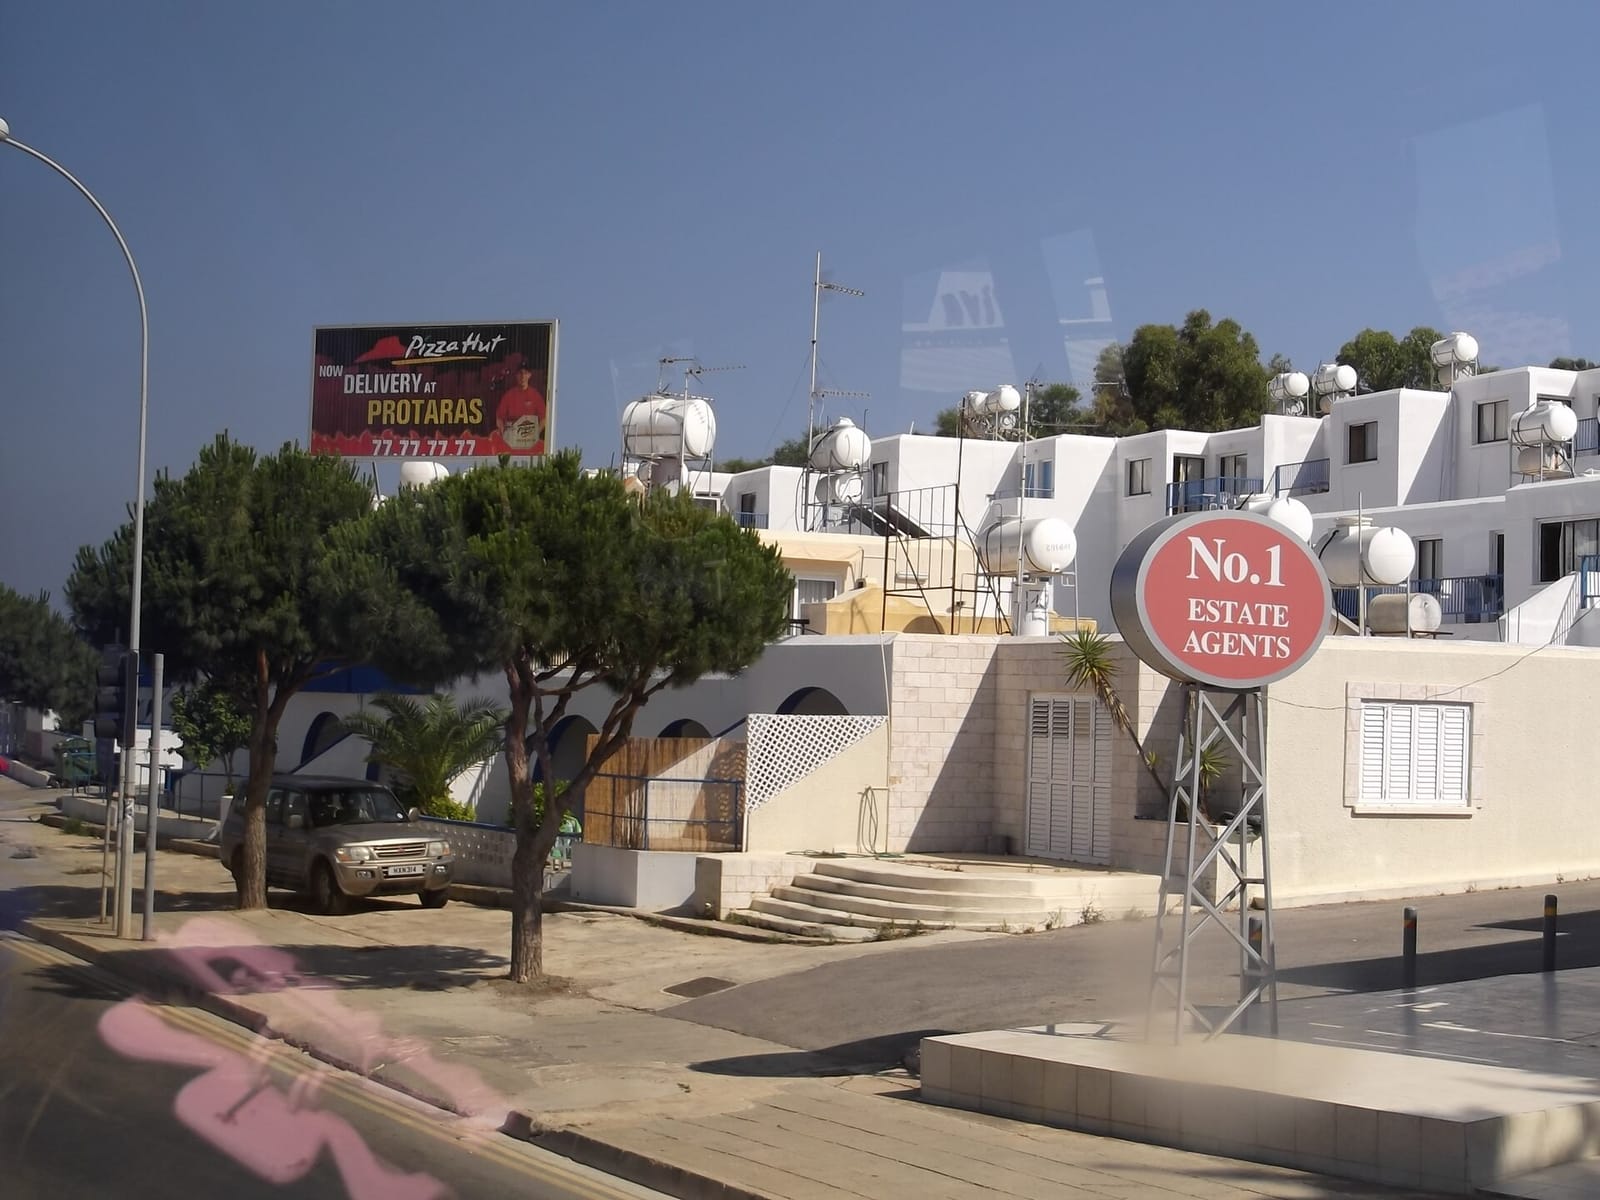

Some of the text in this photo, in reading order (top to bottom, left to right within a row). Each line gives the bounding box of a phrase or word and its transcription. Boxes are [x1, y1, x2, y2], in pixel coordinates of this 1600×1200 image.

[404, 331, 507, 358] Pizza Hut
[319, 365, 344, 378] NOW
[343, 373, 437, 394] DELIVERY AT
[367, 398, 484, 425] PROTARAS
[1186, 536, 1286, 587] No.1
[1187, 598, 1290, 628] ESTATE
[1183, 630, 1291, 659] AGENTS
